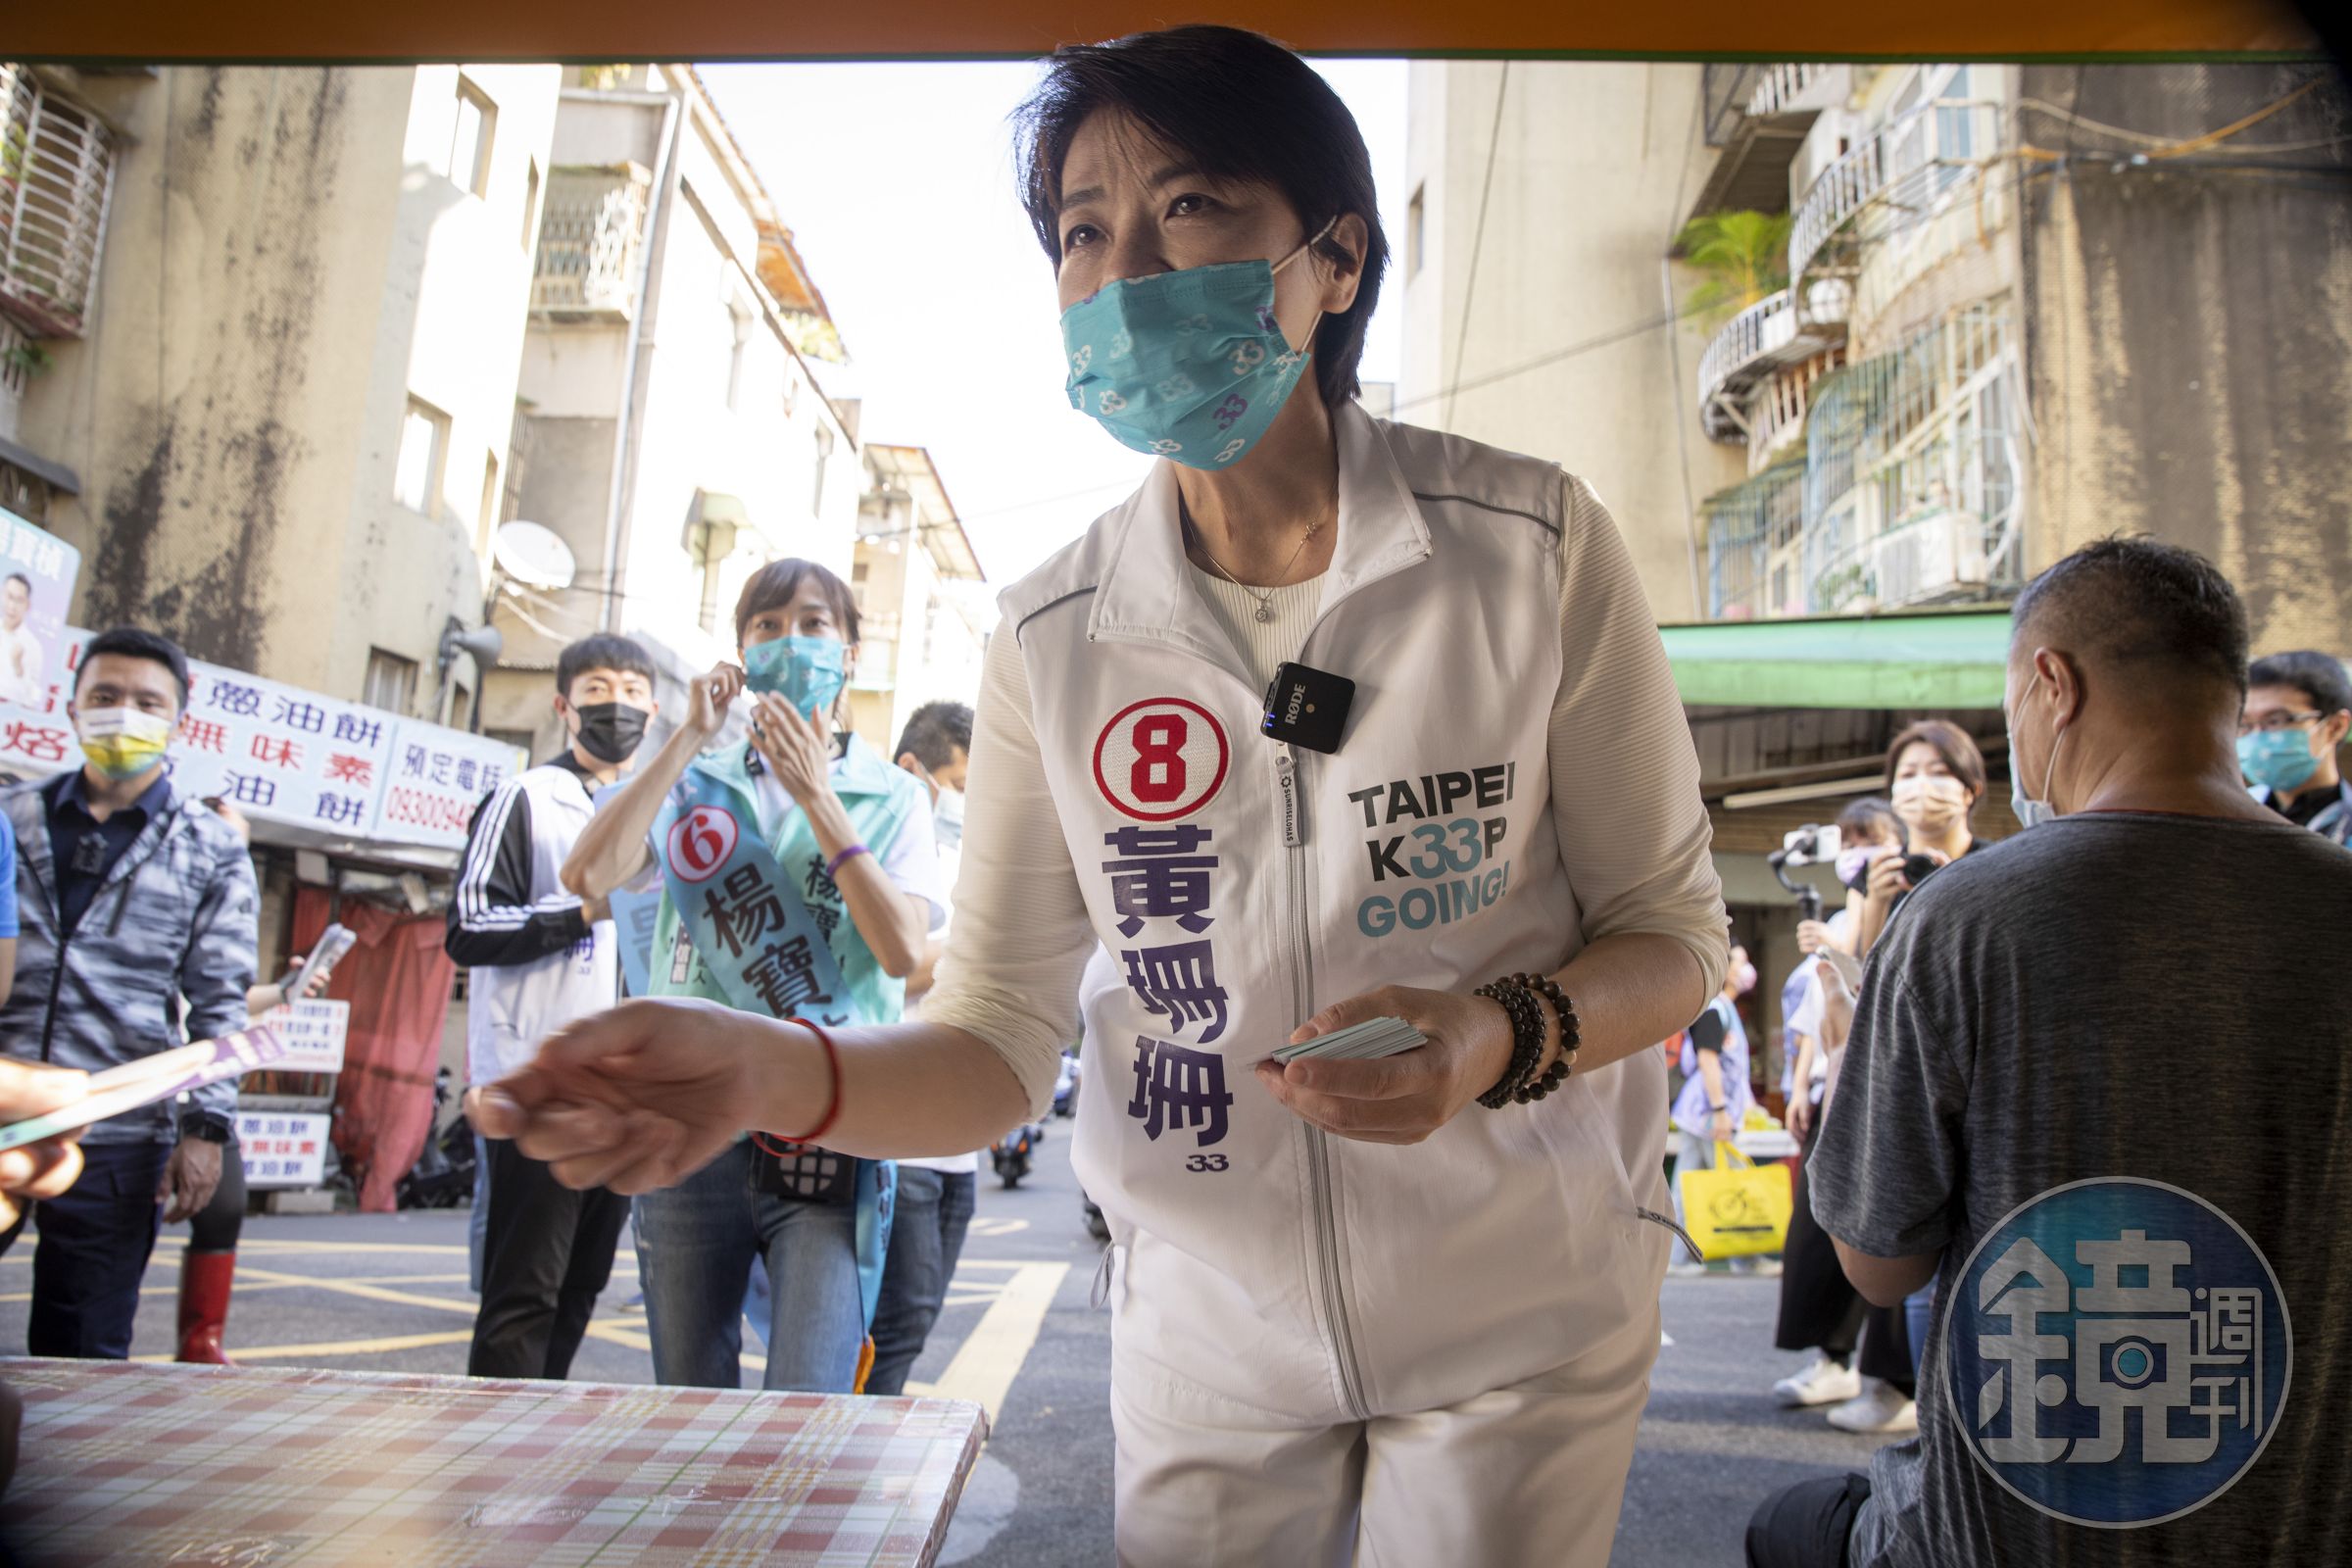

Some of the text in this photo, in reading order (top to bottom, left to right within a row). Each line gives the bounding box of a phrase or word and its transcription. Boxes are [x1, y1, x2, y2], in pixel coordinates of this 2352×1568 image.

[1072, 344, 1092, 376] 33
[1229, 340, 1264, 374] 33
[1099, 390, 1127, 416] 33
[1212, 393, 1248, 430] 33
[1285, 683, 1305, 725] RØDE
[1130, 714, 1188, 803] 8
[1284, 789, 1294, 842] SUNRISELOHAS
[1348, 760, 1515, 828] TAIPEI
[681, 814, 723, 871] 6
[1366, 817, 1507, 882] K33P
[1356, 860, 1510, 938] GOING!
[1102, 824, 1234, 1148] 黃珊珊
[1186, 1153, 1229, 1172] 33
